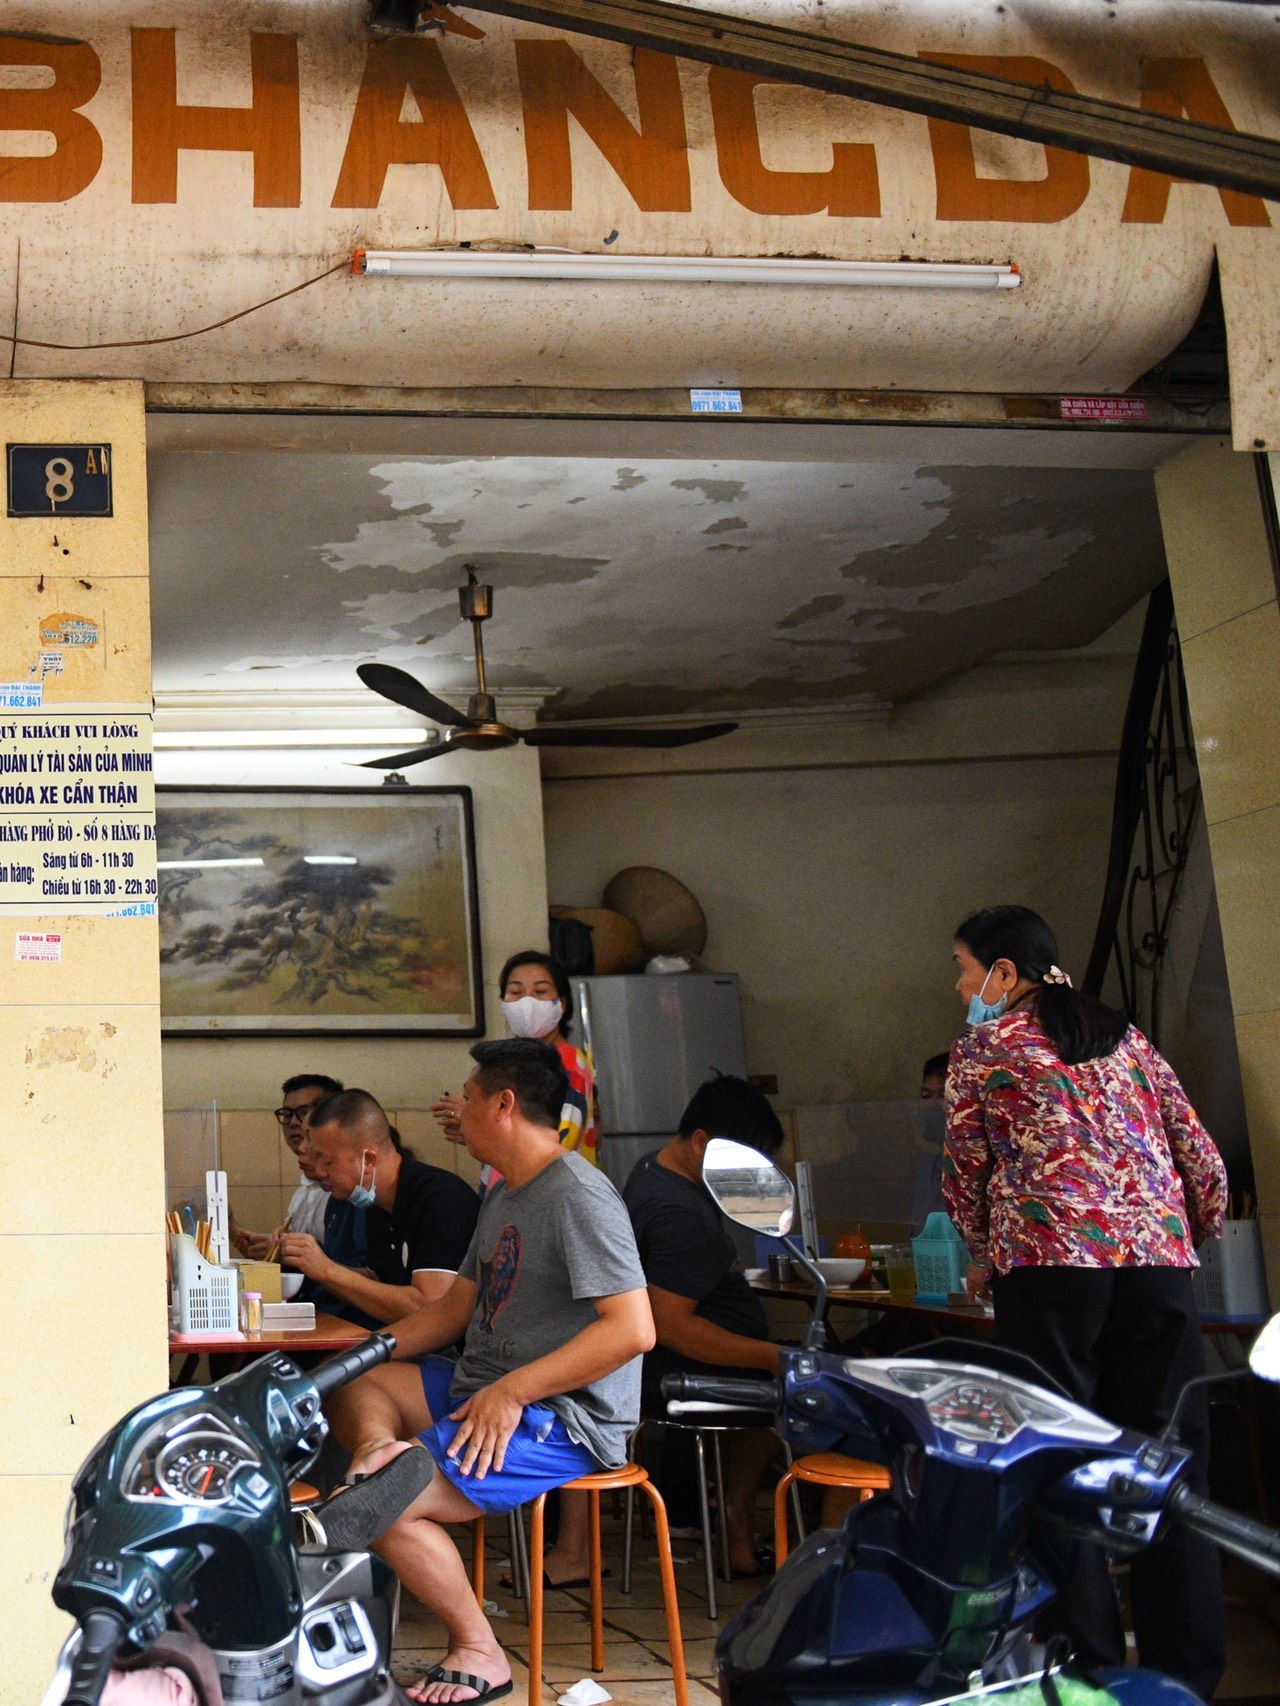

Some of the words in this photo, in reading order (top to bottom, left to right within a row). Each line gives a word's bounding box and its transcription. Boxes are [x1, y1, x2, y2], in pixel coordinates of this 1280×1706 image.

[45, 457, 74, 502] 8
[22, 722, 70, 739] KHÁCH
[75, 725, 97, 738] VUI
[102, 721, 138, 738] LÒNG
[31, 750, 43, 773] LÝ
[47, 750, 65, 773] TÀI
[69, 745, 92, 772] SẢN
[96, 745, 118, 772] CỦA
[122, 749, 152, 772] MÌNH
[40, 786, 58, 804] XE
[63, 778, 94, 804] CẨN
[98, 781, 138, 808] THẬN
[0, 821, 28, 842] HÀNG
[31, 818, 54, 842] PHỞ
[58, 820, 73, 842] BÒ
[83, 816, 98, 842] SỐ
[101, 825, 108, 841] 8
[111, 820, 140, 841] HÀNG
[10, 861, 35, 885] hàng:
[43, 852, 66, 870] Sáng
[69, 851, 78, 868] từ
[81, 852, 92, 867] 6h
[102, 852, 119, 867] 11h
[122, 852, 134, 867] 30
[42, 876, 69, 895] Chiều
[72, 878, 82, 895] từ
[84, 879, 101, 895] 16h
[104, 879, 116, 894] 30
[125, 879, 142, 894] 22h
[145, 879, 157, 894] 30
